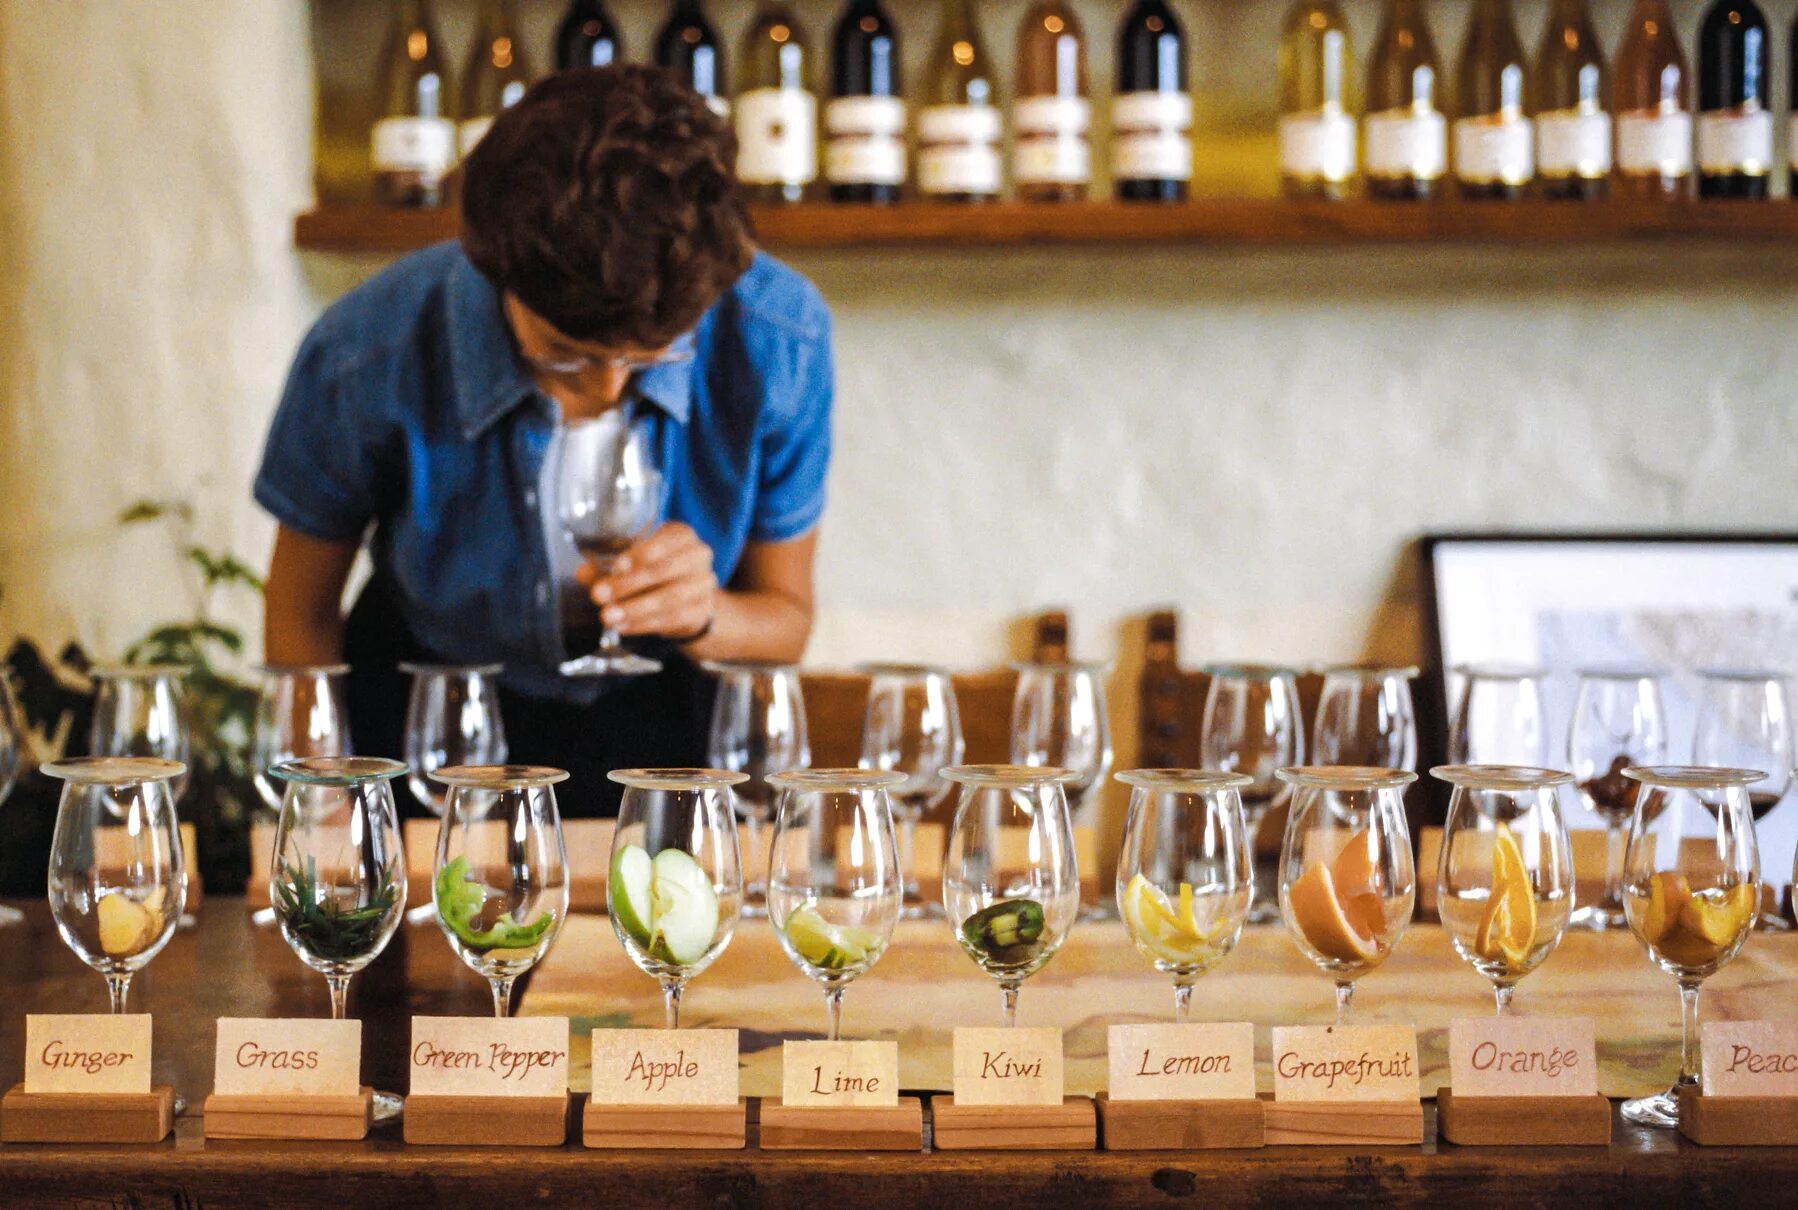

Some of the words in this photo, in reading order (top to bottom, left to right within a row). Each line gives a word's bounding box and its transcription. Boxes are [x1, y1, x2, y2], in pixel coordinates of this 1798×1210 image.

[41, 1040, 133, 1073] Ginger
[236, 1041, 319, 1070] Grass
[412, 1041, 481, 1070] Green
[488, 1043, 566, 1081] Pepper
[624, 1050, 699, 1092] Apple
[981, 1051, 1042, 1079] Kiwi
[1136, 1049, 1232, 1076] Lemon
[1278, 1051, 1413, 1088] Grapefruit
[1471, 1041, 1580, 1077] Orange
[810, 1066, 880, 1095] Lime
